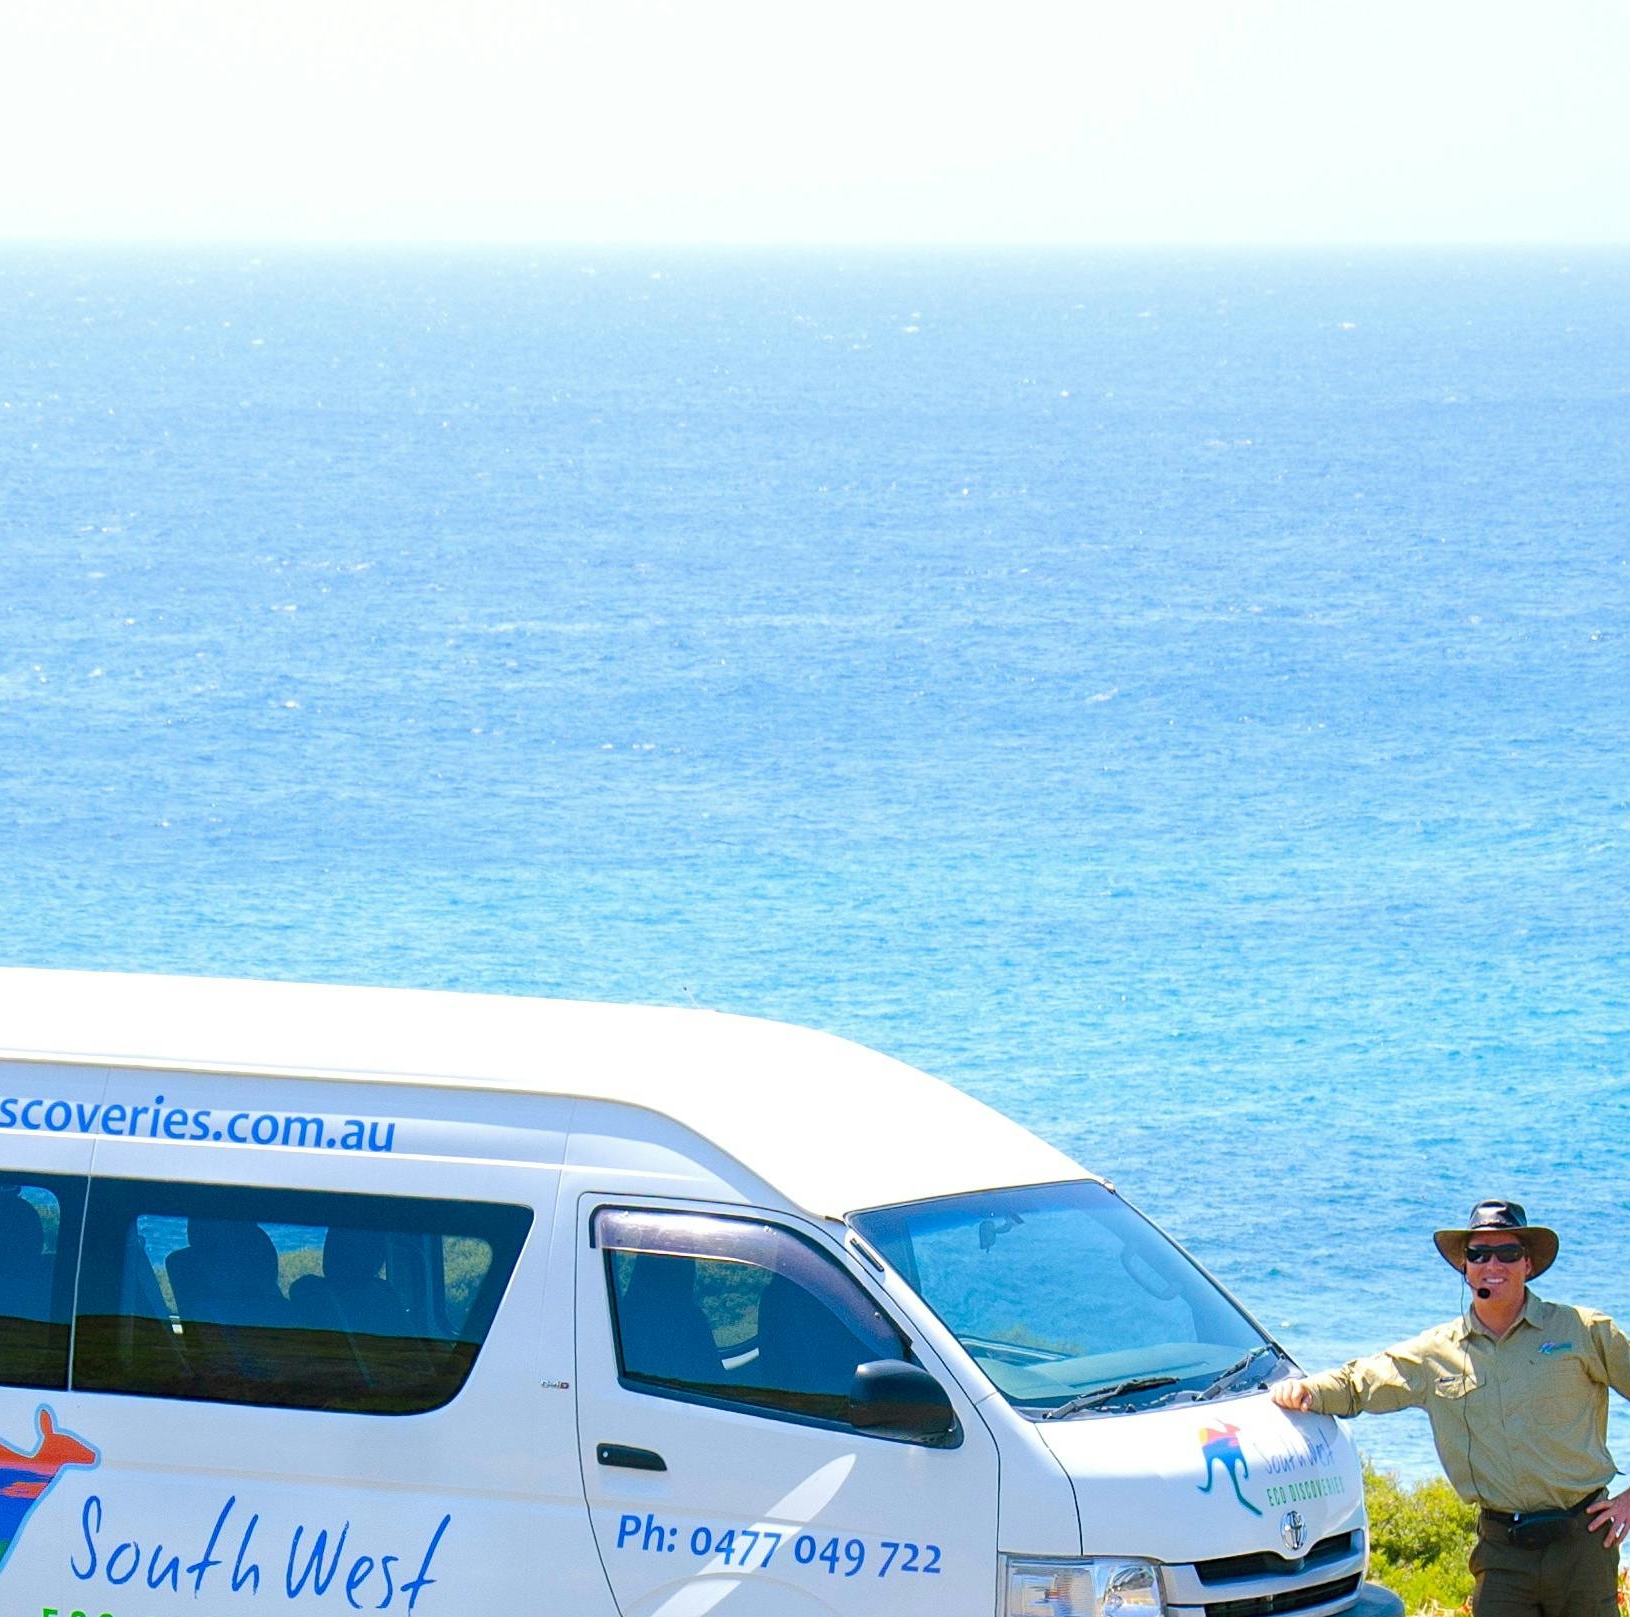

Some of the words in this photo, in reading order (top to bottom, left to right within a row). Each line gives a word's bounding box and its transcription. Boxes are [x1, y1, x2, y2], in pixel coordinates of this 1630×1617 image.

[1266, 1487, 1287, 1507] ECO
[1289, 1476, 1345, 1502] DISCOVERIES
[71, 1495, 260, 1599] South
[285, 1513, 451, 1617] West
[616, 1513, 679, 1553] Ph:
[689, 1526, 783, 1569] 0477
[794, 1535, 866, 1578] 049
[877, 1541, 943, 1578] 722
